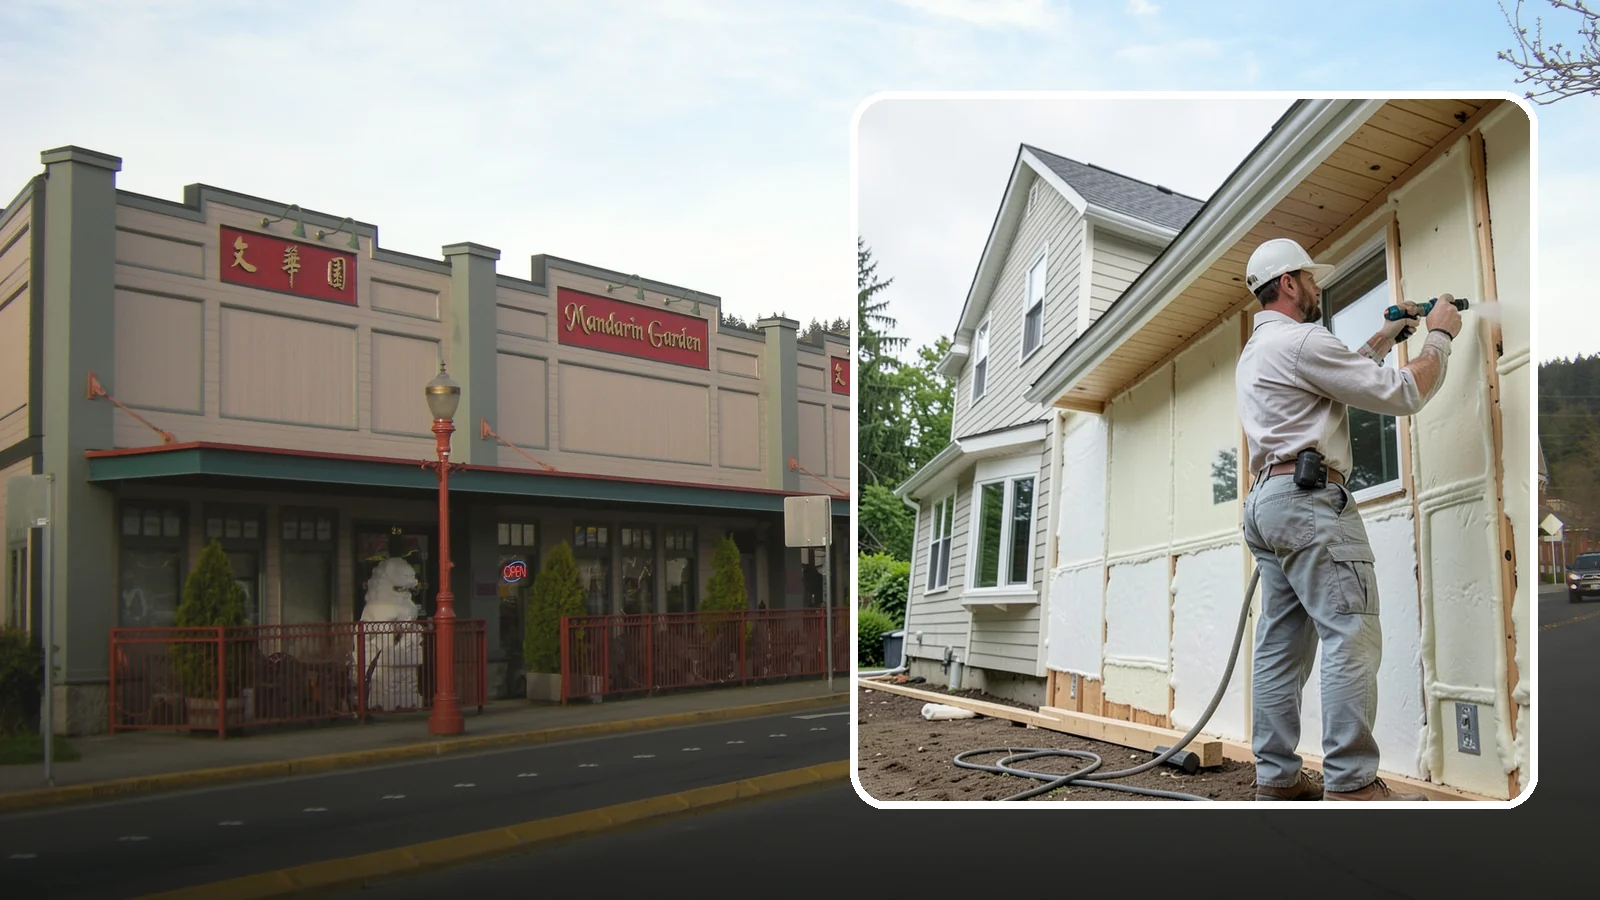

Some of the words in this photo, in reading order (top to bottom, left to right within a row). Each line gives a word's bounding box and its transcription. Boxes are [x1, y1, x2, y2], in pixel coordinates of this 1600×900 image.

[564, 303, 644, 341] Mandarin
[648, 321, 701, 352] Garden
[503, 565, 527, 578] OPEN
